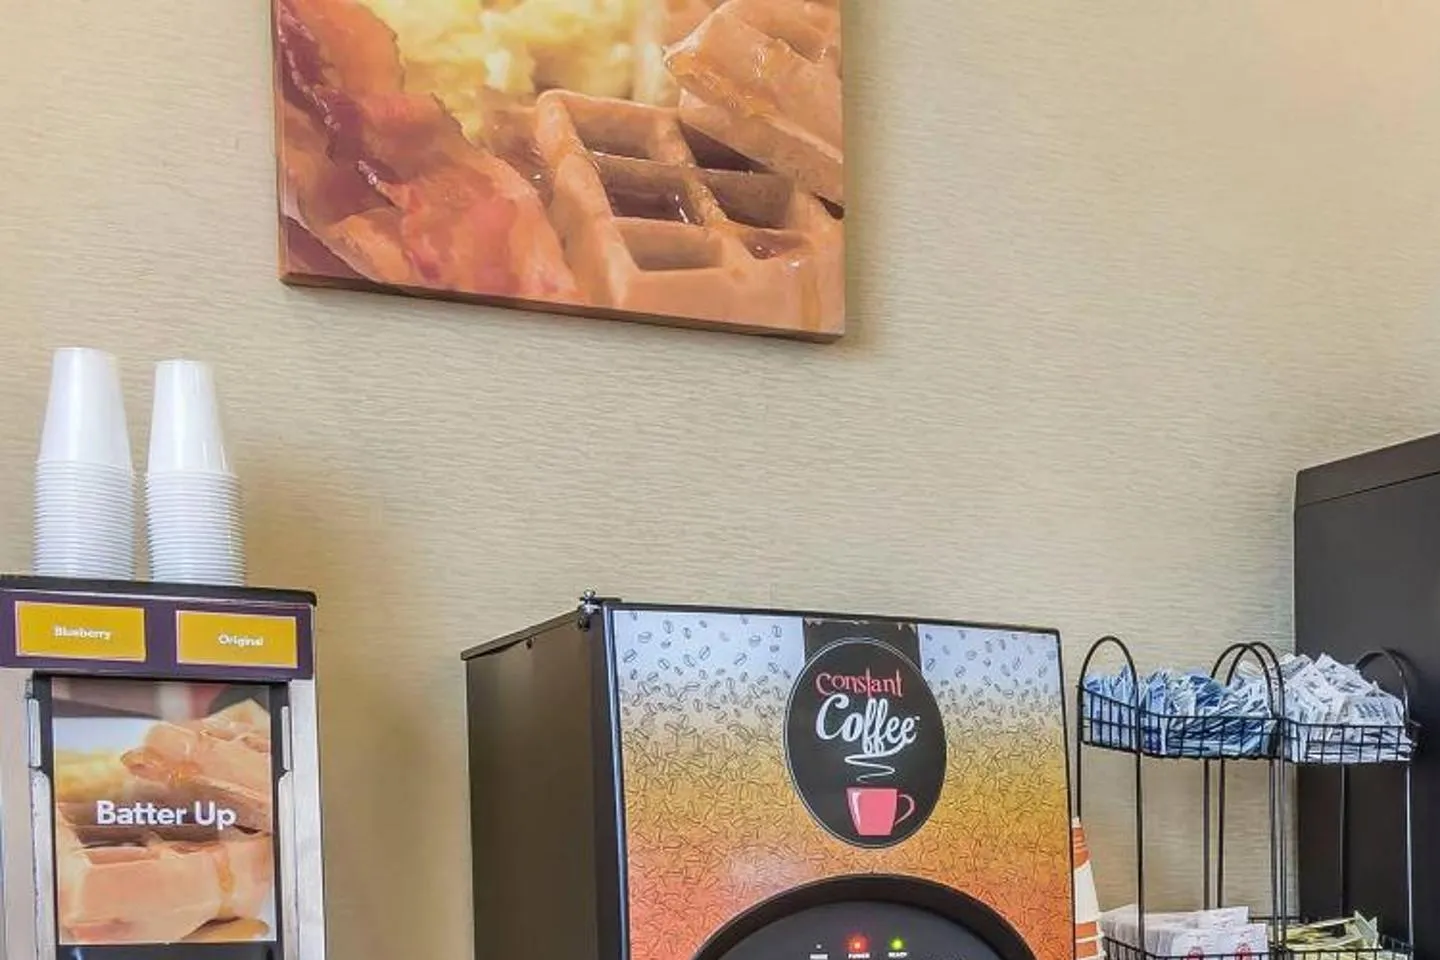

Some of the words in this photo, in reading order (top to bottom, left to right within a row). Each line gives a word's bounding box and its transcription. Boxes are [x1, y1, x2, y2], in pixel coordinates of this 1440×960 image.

[54, 625, 111, 641] Blueberry
[218, 634, 264, 648] Original
[816, 693, 917, 756] Coffee
[96, 800, 187, 826] Batter
[194, 802, 237, 829] Up
